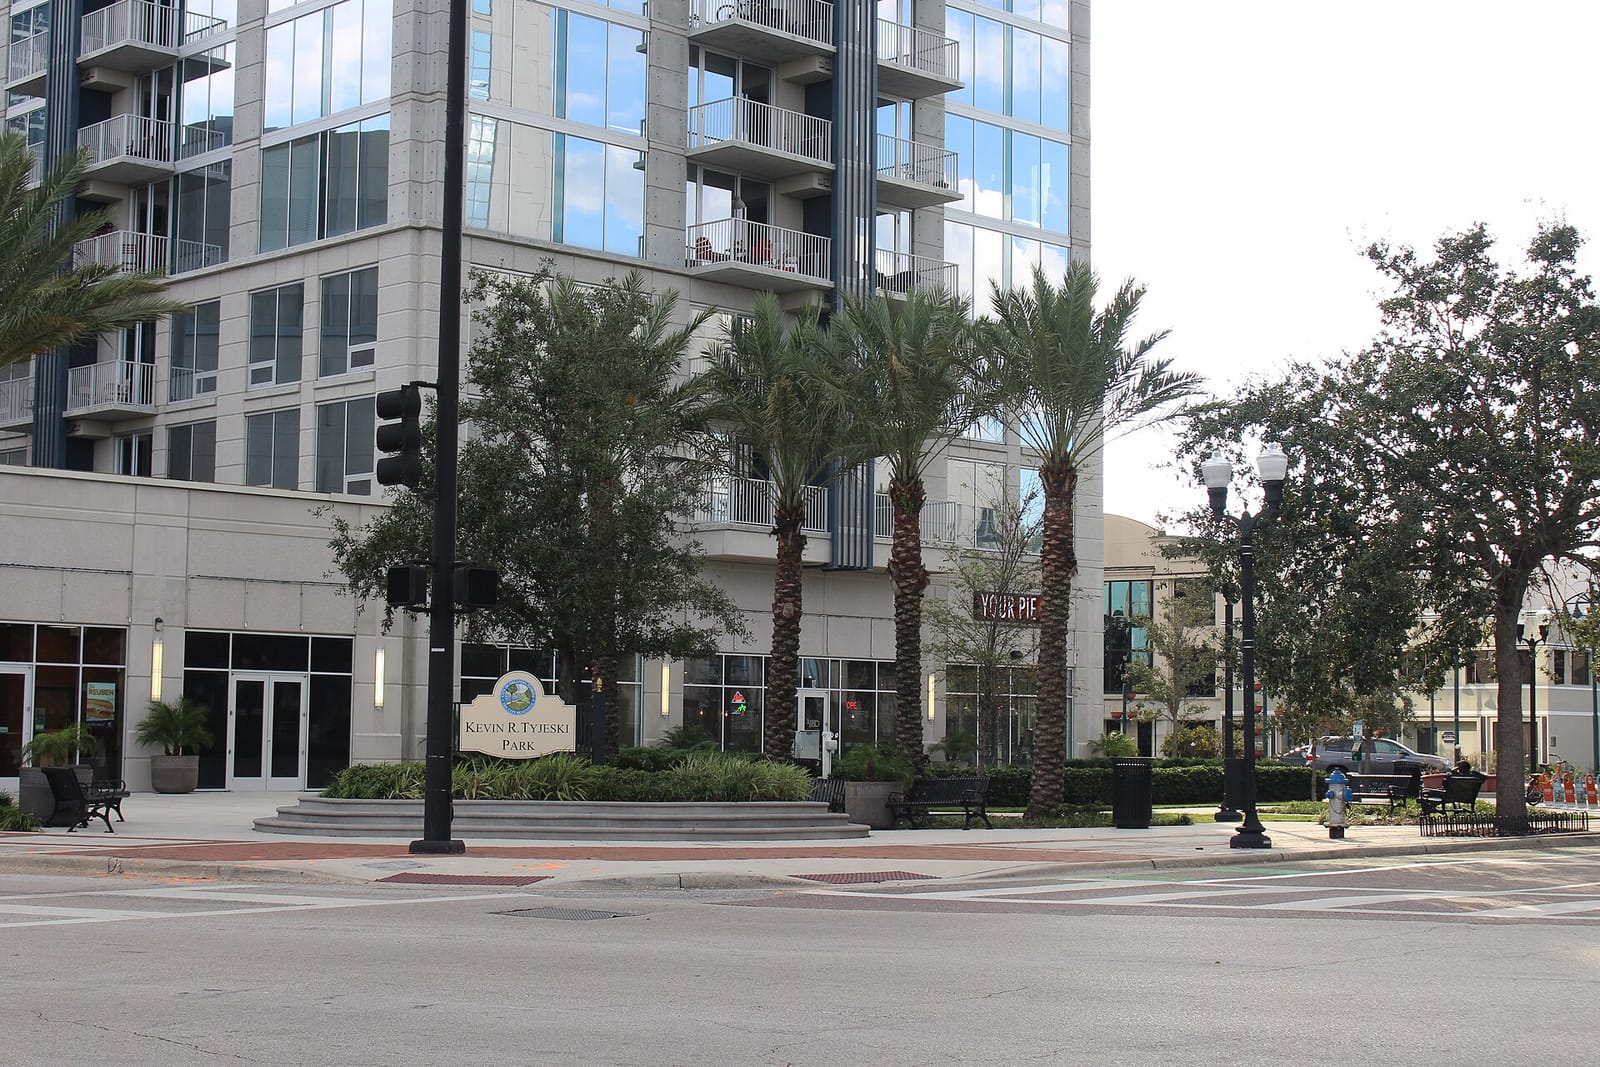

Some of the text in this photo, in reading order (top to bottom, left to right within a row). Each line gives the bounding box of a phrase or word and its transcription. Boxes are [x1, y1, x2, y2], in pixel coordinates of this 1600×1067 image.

[981, 594, 1015, 619] YOUR
[465, 721, 569, 734] KEVIN R. TYJESKI
[502, 739, 535, 751] PARK
